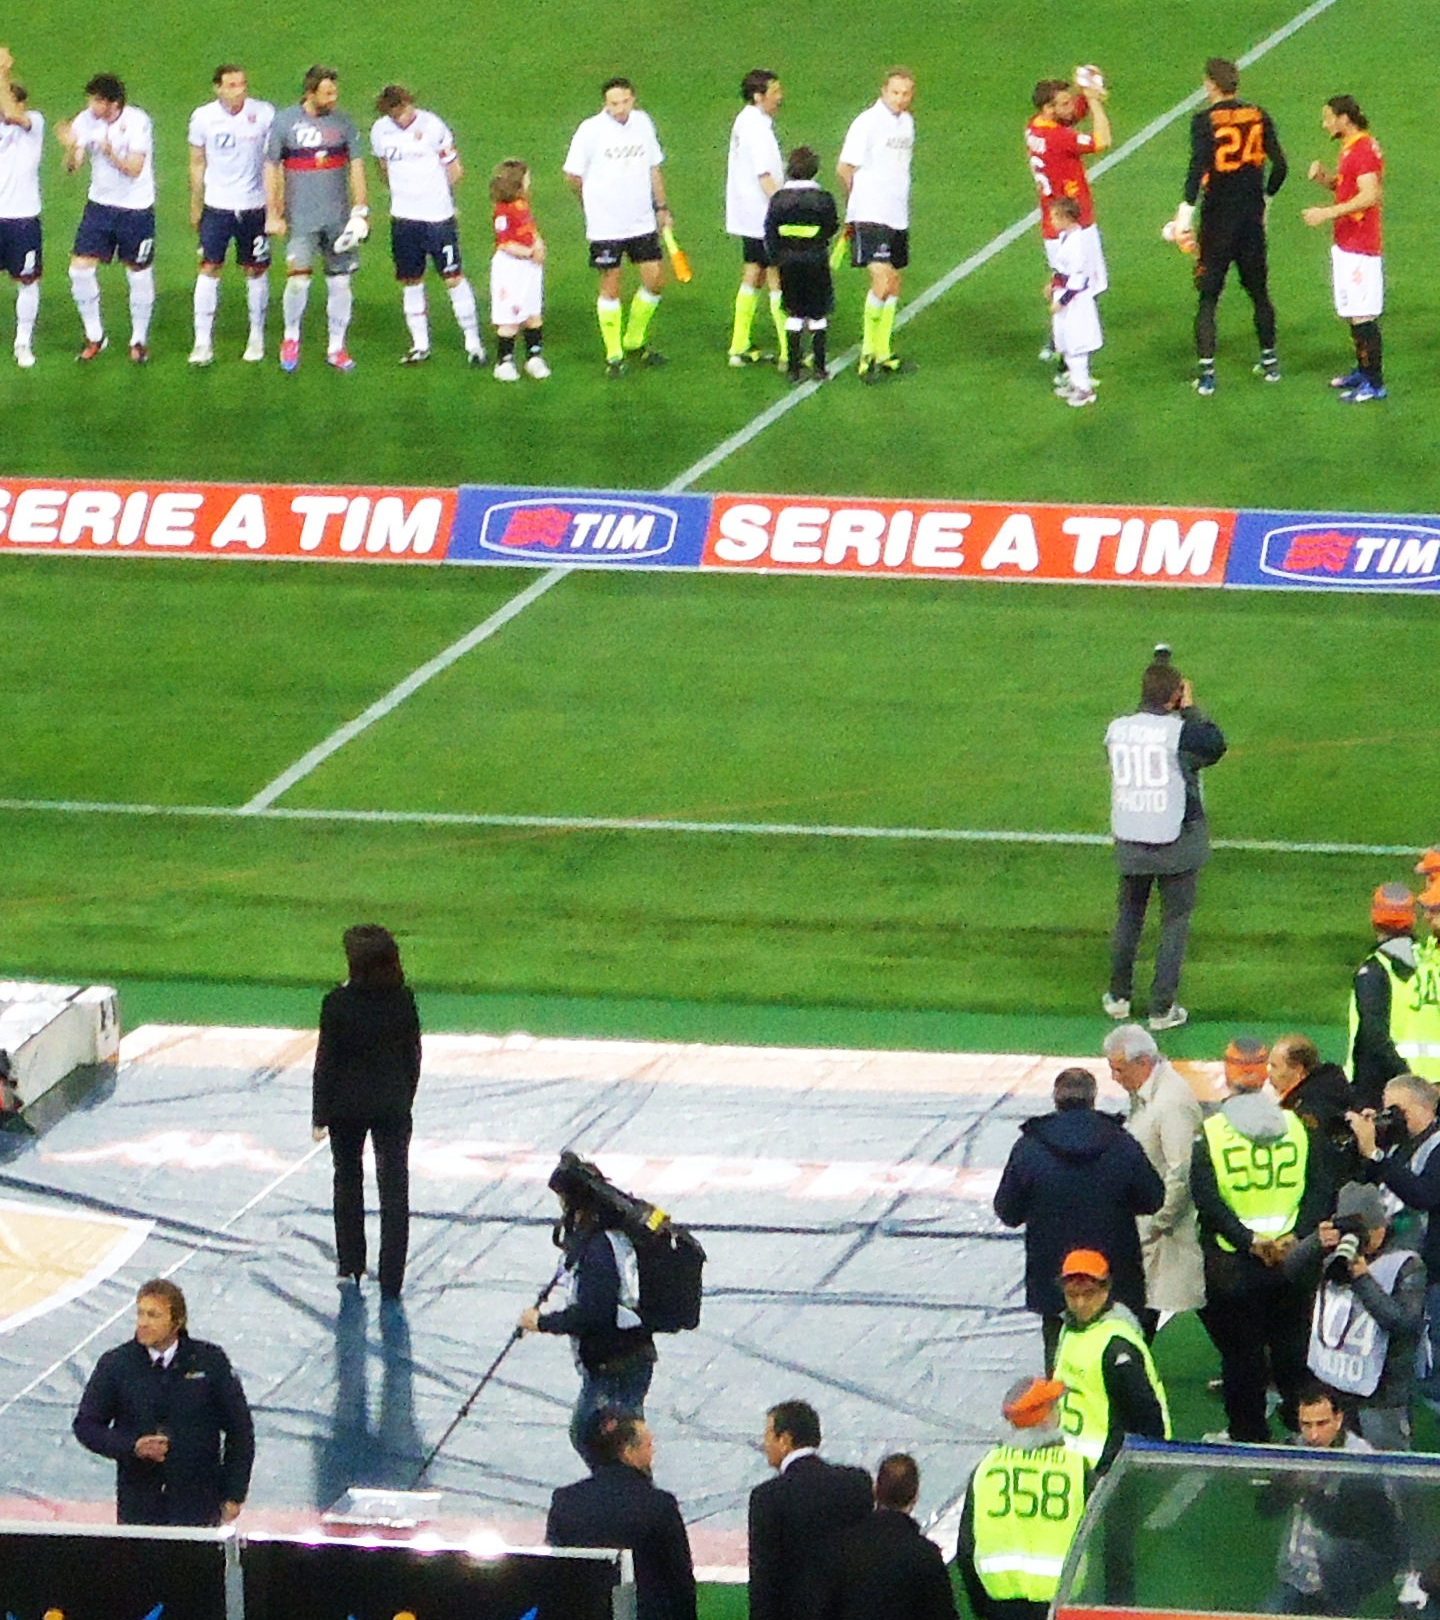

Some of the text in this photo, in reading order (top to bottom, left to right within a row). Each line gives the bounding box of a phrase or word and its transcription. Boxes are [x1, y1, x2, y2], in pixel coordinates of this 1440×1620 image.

[1214, 125, 1267, 173] 24
[210, 493, 268, 549] A
[289, 494, 443, 555] TIM
[569, 512, 657, 551] TIM
[714, 503, 1220, 576] SERIE A TIM
[1112, 743, 1170, 788] 010
[1222, 1140, 1298, 1191] 592
[985, 1467, 1072, 1522] 358
